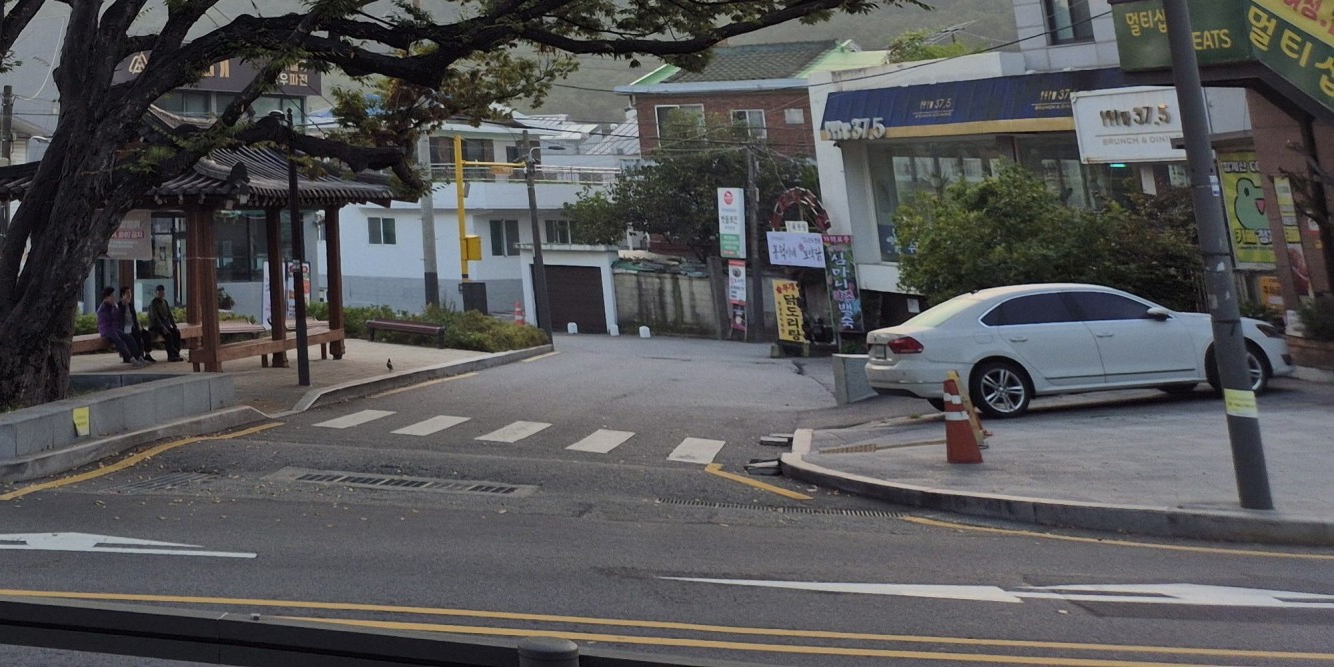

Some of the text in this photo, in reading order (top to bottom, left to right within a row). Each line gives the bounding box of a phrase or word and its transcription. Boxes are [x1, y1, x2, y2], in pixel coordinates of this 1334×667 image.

[1192, 29, 1231, 49] EATS
[276, 72, 309, 87] 우파전
[1102, 135, 1179, 145] BRUNCH & DINI
